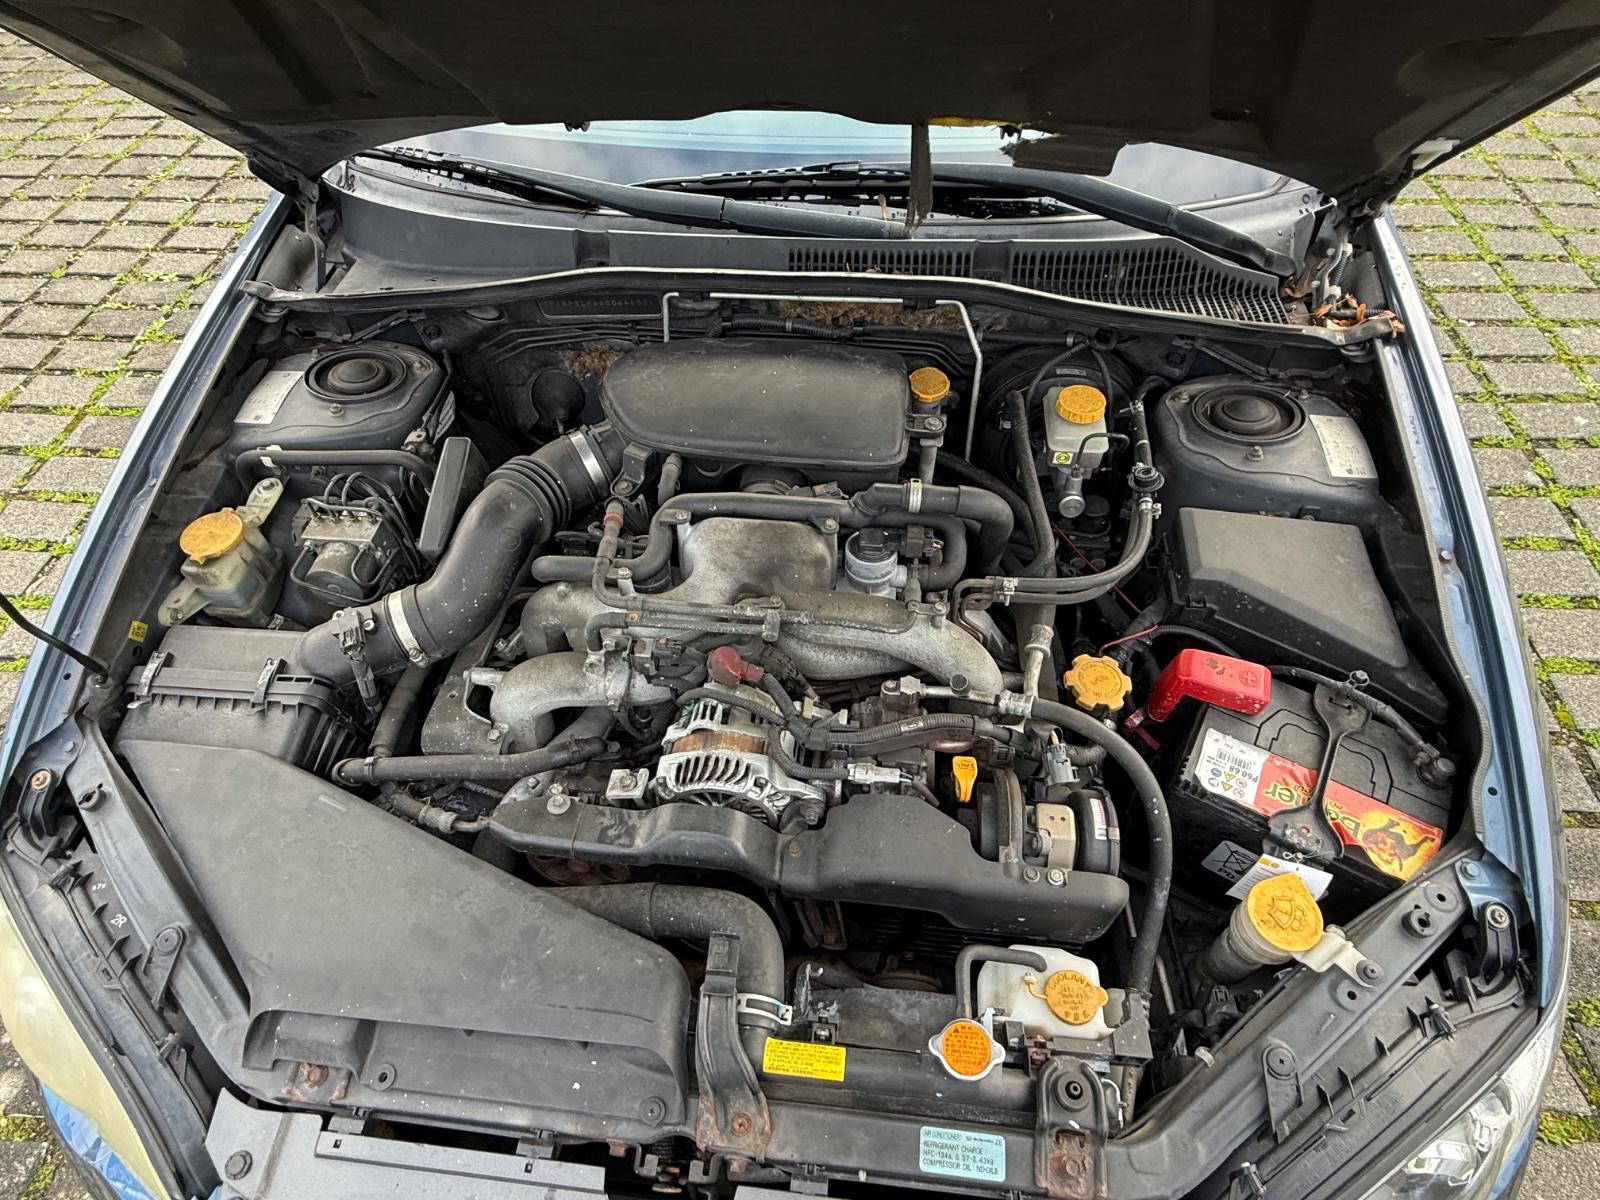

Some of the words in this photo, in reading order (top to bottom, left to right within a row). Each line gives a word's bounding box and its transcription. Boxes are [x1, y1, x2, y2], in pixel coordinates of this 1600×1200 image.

[1229, 765, 1240, 775] 68
[1242, 770, 1258, 783] P60
[1217, 868, 1235, 879] Pb
[1049, 972, 1090, 989] COOLANT
[923, 1140, 960, 1151] REFRIGERANT
[961, 1145, 984, 1155] CHARGE
[923, 1158, 960, 1170] COMPRESSOR
